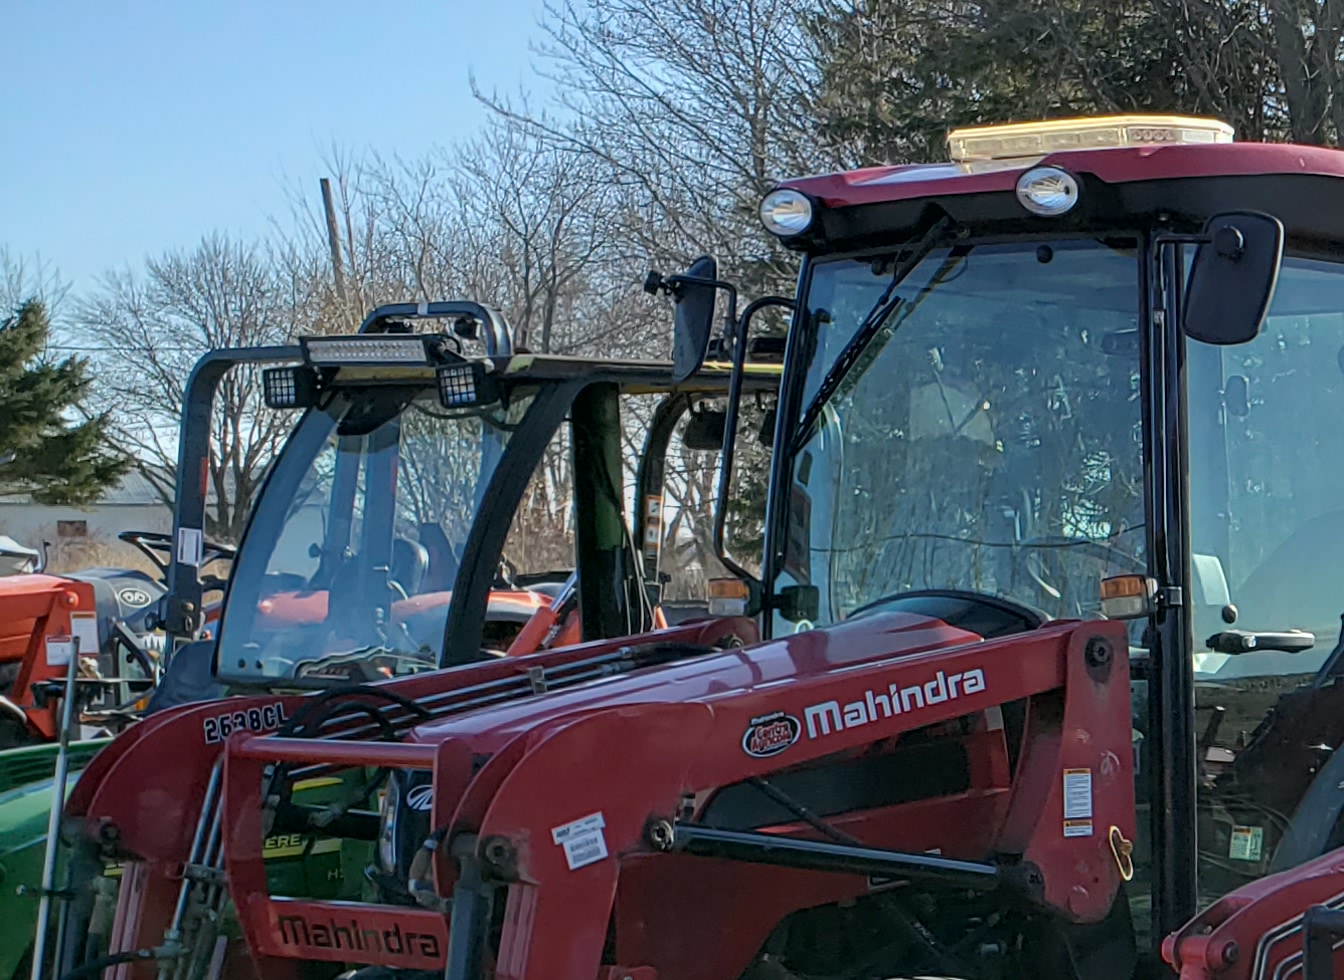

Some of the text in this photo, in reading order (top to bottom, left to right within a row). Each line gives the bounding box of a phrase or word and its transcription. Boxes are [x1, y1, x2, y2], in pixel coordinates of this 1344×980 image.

[803, 668, 986, 740] Mahindra
[263, 834, 303, 849] ERE
[278, 914, 441, 959] Mahindra
